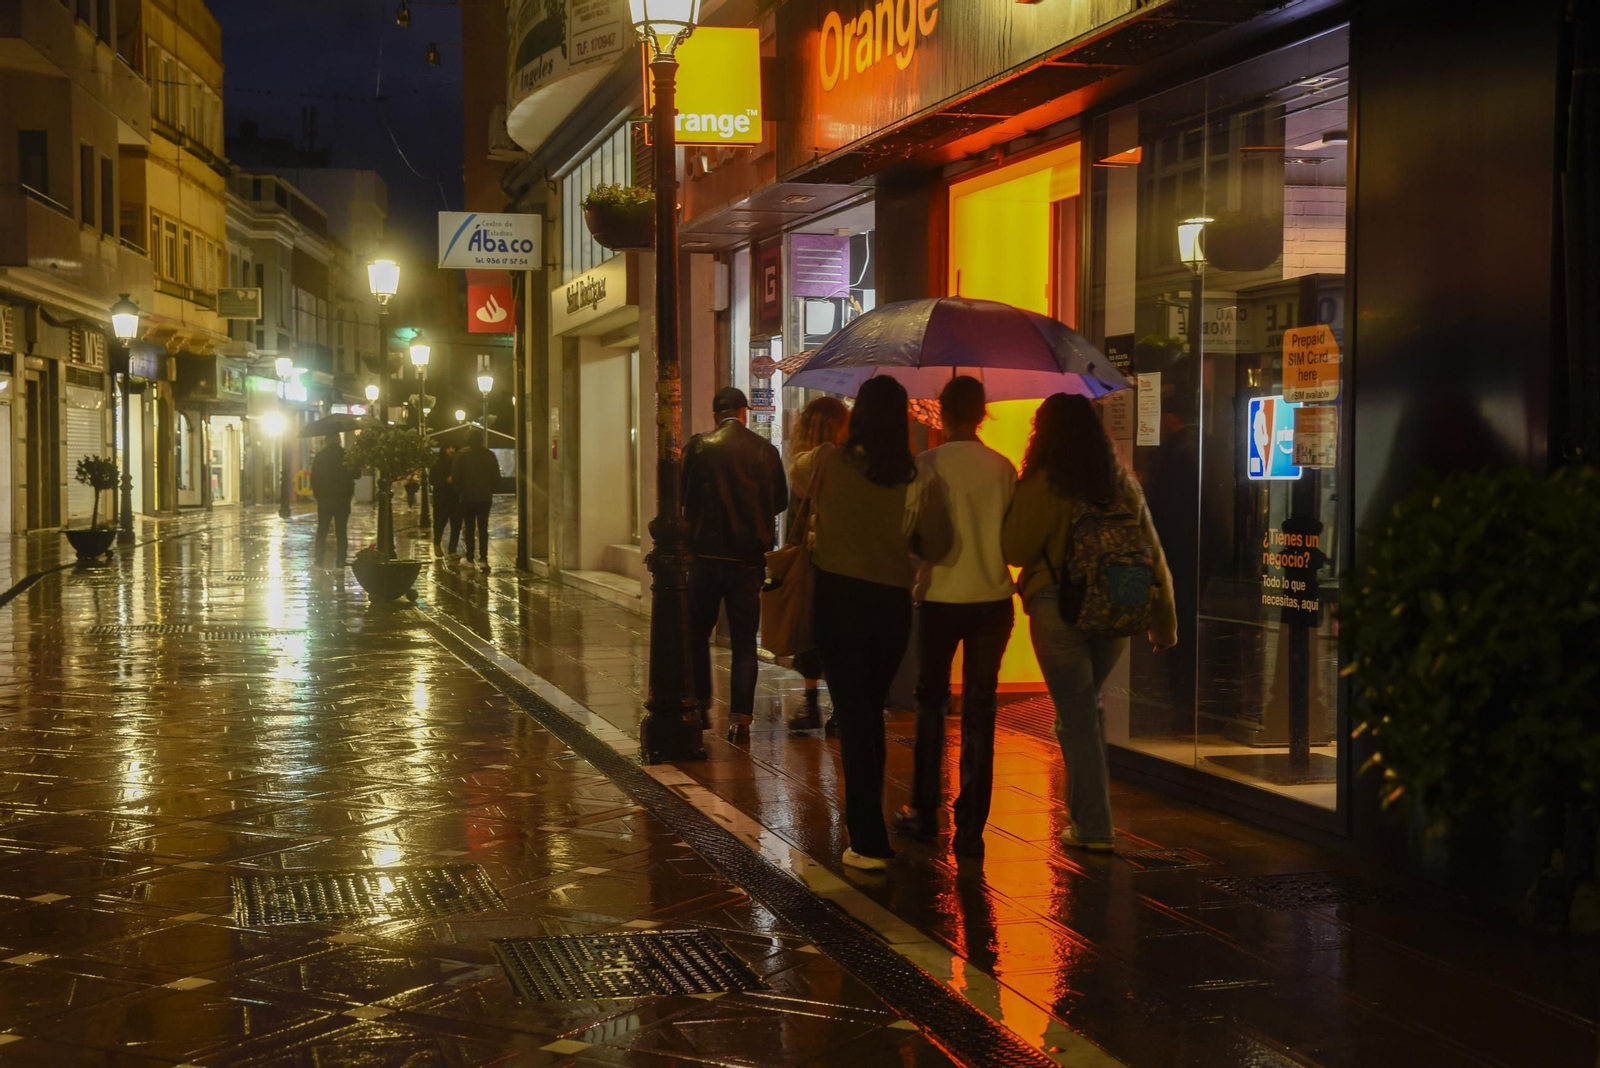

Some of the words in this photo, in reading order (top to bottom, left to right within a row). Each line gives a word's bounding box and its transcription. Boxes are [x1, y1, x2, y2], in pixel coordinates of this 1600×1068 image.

[820, 0, 938, 91] Orange
[674, 113, 750, 138] range
[468, 224, 533, 253] Ábaco
[1292, 331, 1326, 349] Prepaid
[1288, 352, 1304, 366] SIM
[1307, 350, 1329, 364] Card
[1297, 368, 1318, 382] here
[1305, 389, 1330, 400] available
[1262, 528, 1303, 549] ¿Tienes
[1305, 534, 1320, 548] un
[1262, 551, 1310, 570] negocio?
[1262, 574, 1281, 588] Todo
[1282, 576, 1290, 589] lo
[1291, 580, 1306, 593] que
[1261, 594, 1300, 611] necesitas,
[1301, 597, 1319, 613] aquí
